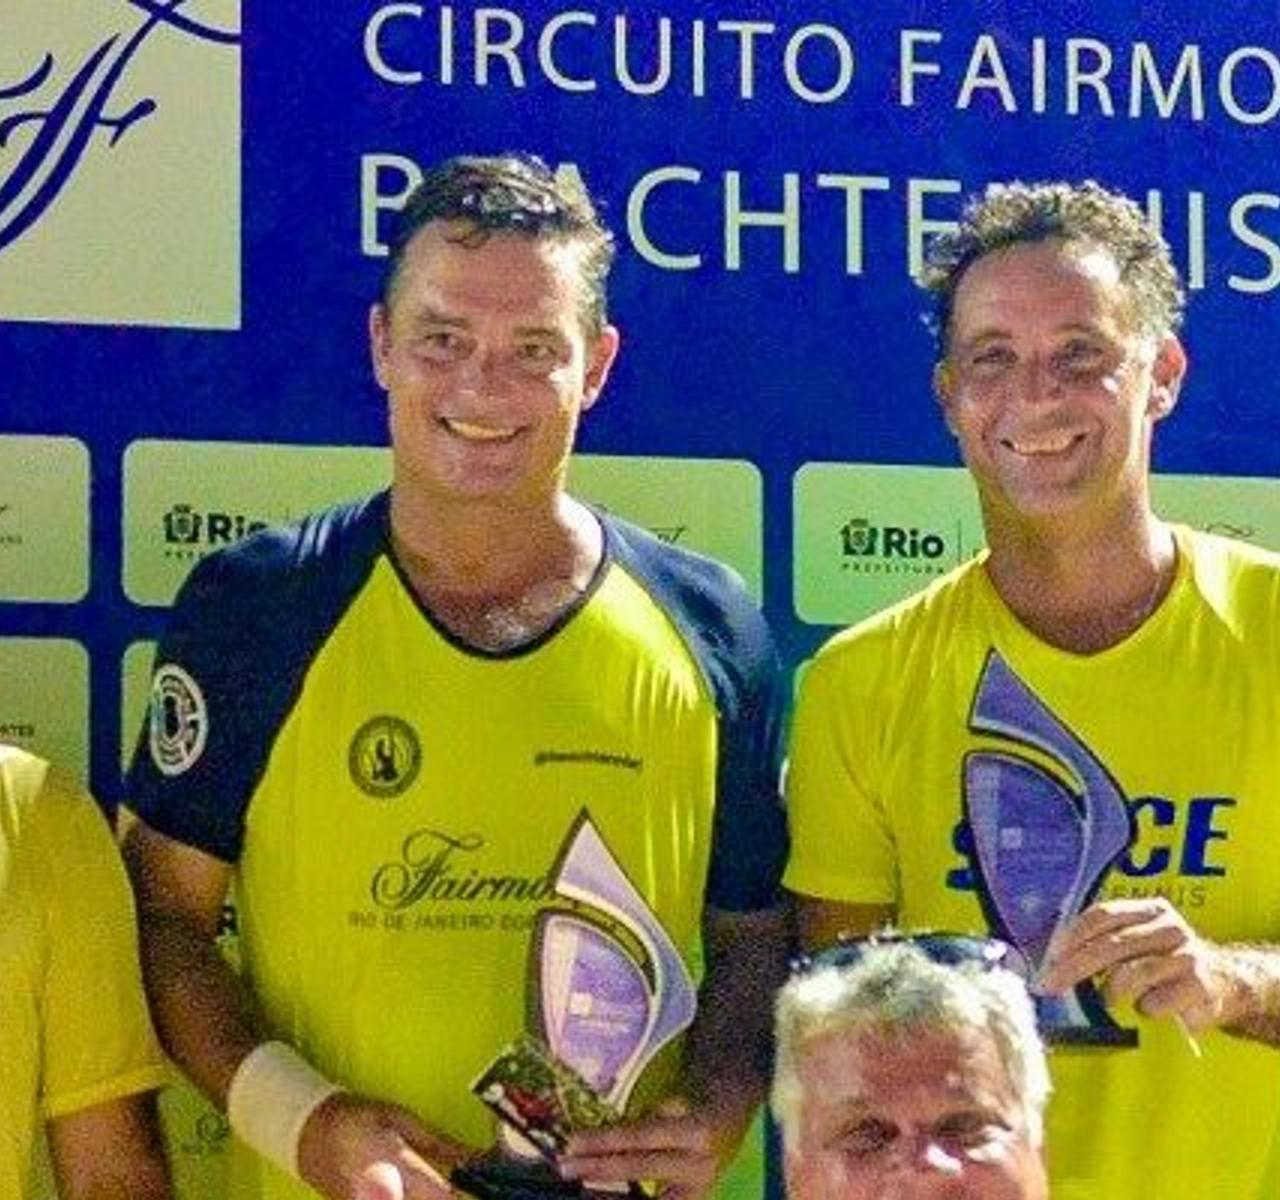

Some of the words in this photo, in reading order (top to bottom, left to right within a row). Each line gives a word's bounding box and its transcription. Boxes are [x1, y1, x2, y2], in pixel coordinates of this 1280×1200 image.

[363, 3, 854, 103] CIRCUITO
[883, 527, 945, 559] Rio
[371, 828, 555, 910] Fairmo
